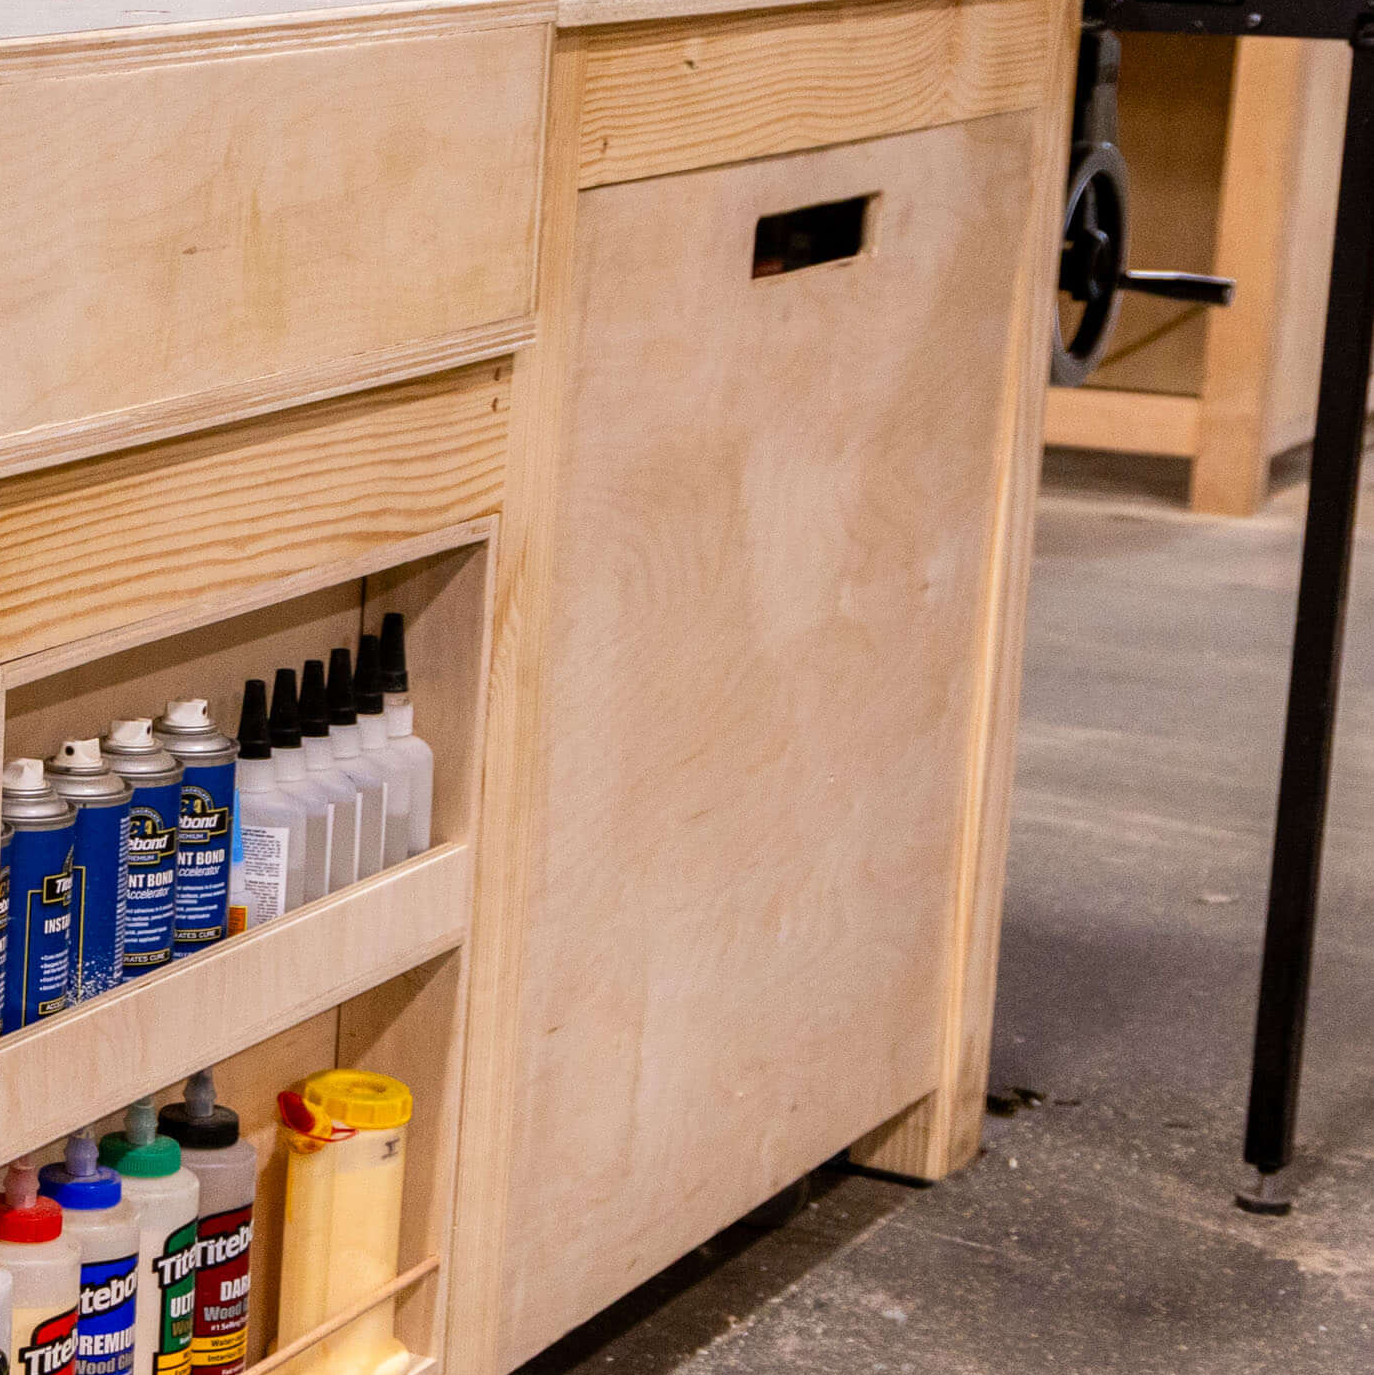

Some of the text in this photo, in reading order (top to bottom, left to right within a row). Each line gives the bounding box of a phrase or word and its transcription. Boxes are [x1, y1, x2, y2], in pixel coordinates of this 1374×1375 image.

[196, 848, 226, 866] BOND
[146, 869, 174, 888] BOND
[177, 864, 221, 878] ccelerator
[79, 1267, 139, 1316] tebo
